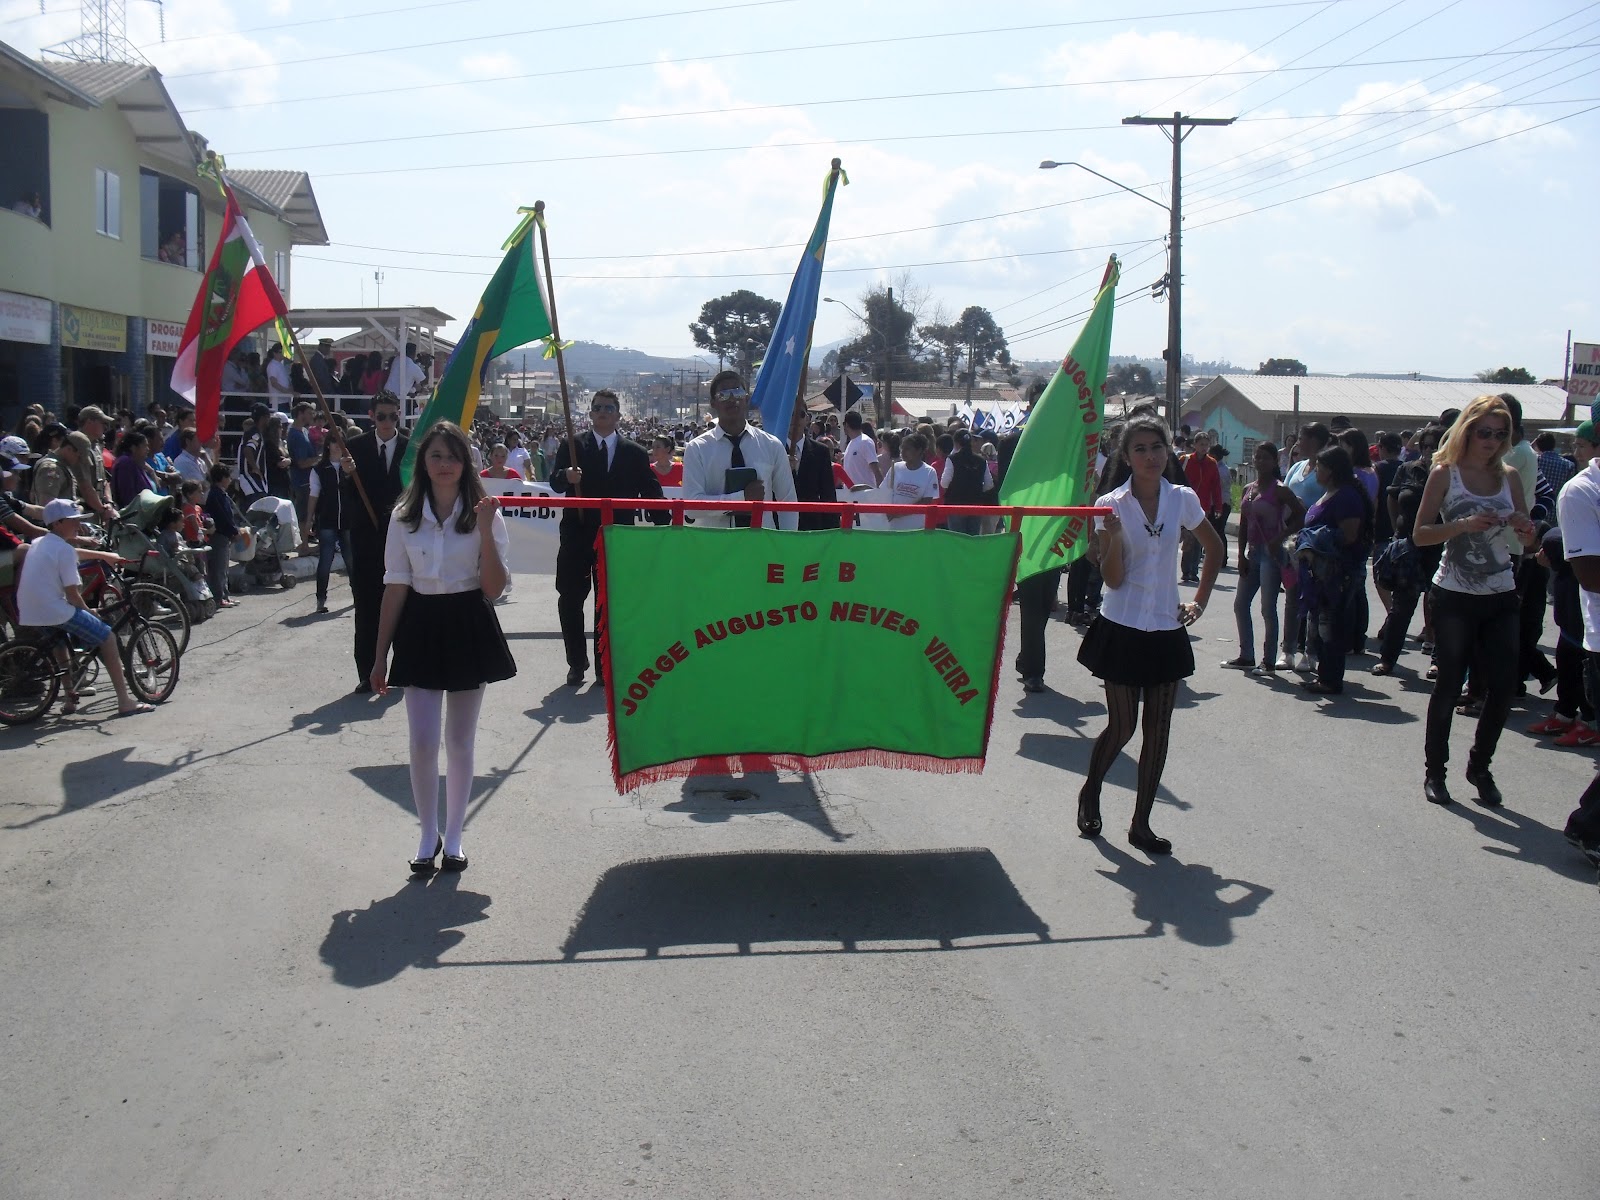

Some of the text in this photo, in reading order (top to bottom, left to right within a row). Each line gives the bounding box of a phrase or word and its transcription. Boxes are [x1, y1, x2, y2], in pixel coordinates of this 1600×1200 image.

[1569, 379, 1600, 396] 322
[620, 600, 979, 717] JORGE AUGUSTO NEVES VIEIRA
